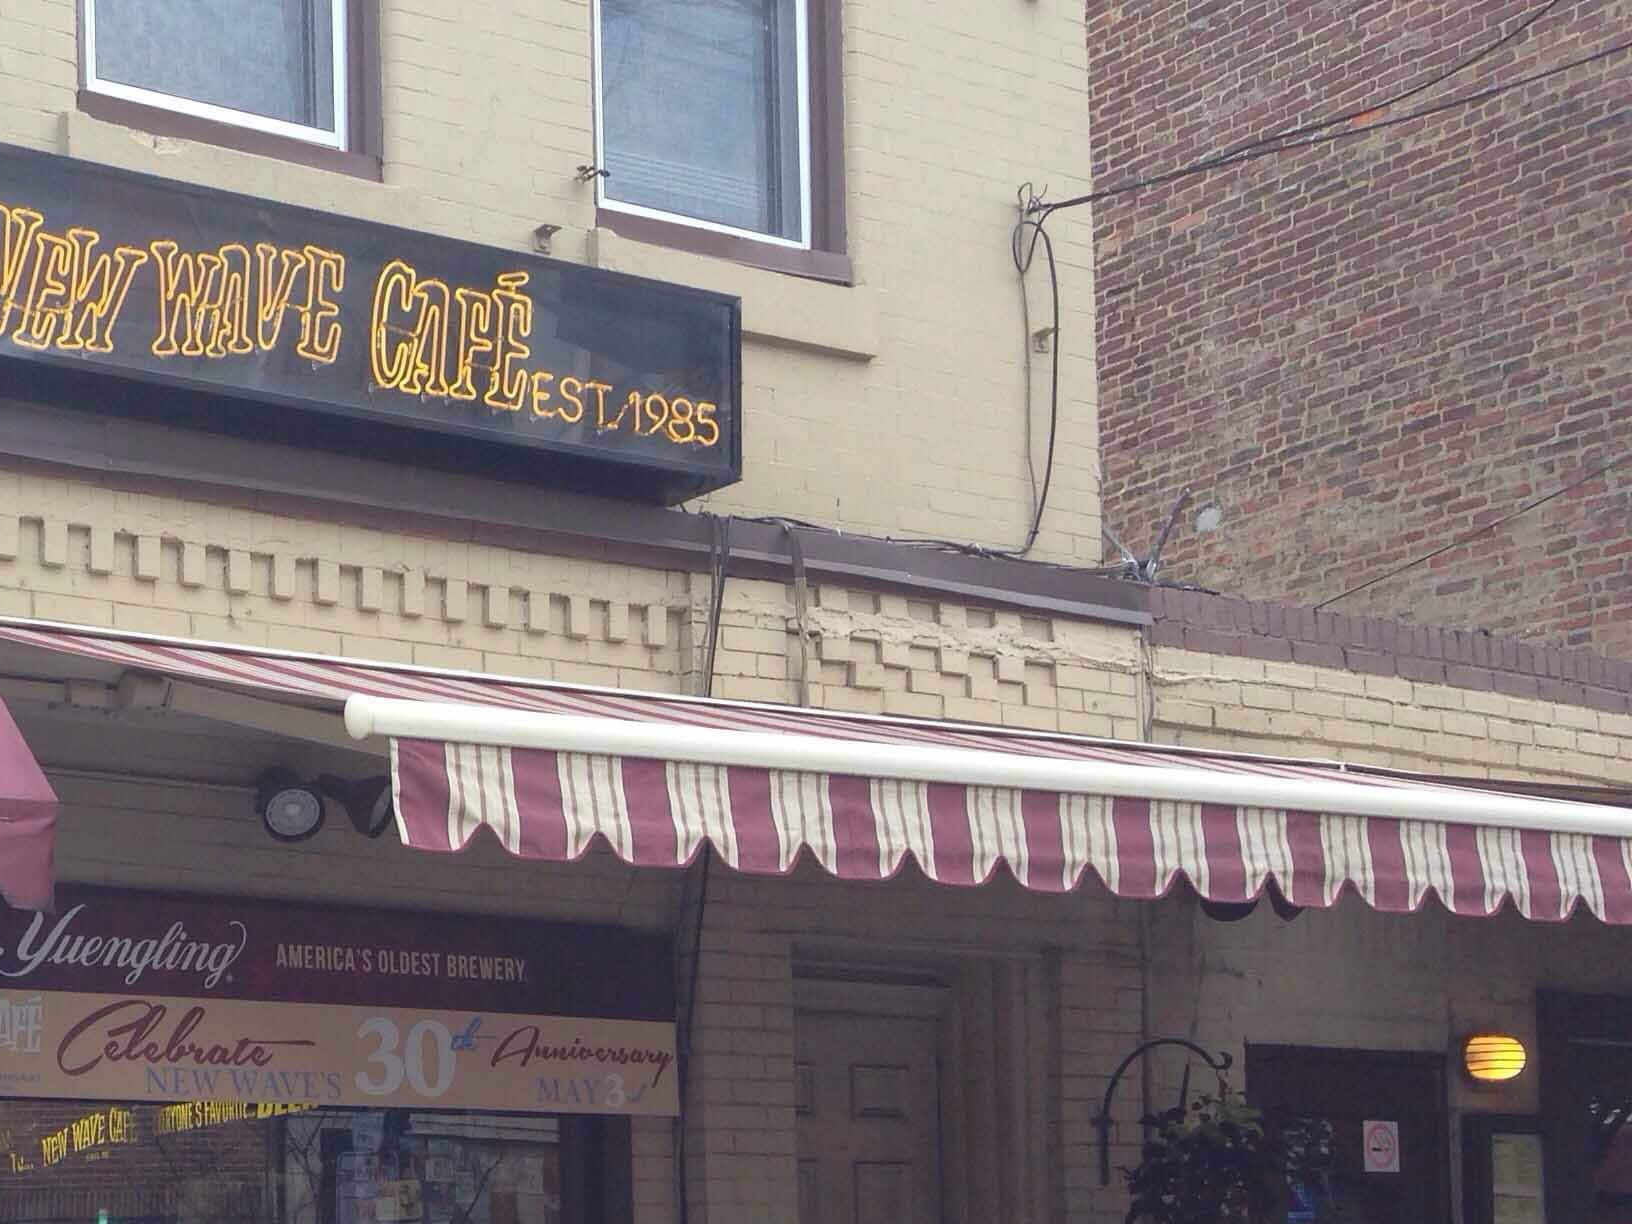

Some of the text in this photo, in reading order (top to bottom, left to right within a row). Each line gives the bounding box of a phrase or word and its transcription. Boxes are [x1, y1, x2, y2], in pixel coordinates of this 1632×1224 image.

[150, 240, 346, 364] WAVE
[371, 261, 533, 412] CAFÉ
[275, 943, 373, 973] AMERICA'S
[377, 949, 441, 977] OLDEST
[56, 999, 316, 1076] Celebrate
[490, 1025, 674, 1088] Anniversary
[144, 1065, 218, 1096] NEW
[231, 1067, 344, 1100] WAVE'S
[41, 1127, 69, 1167] NEW
[72, 1113, 105, 1152] WAVE
